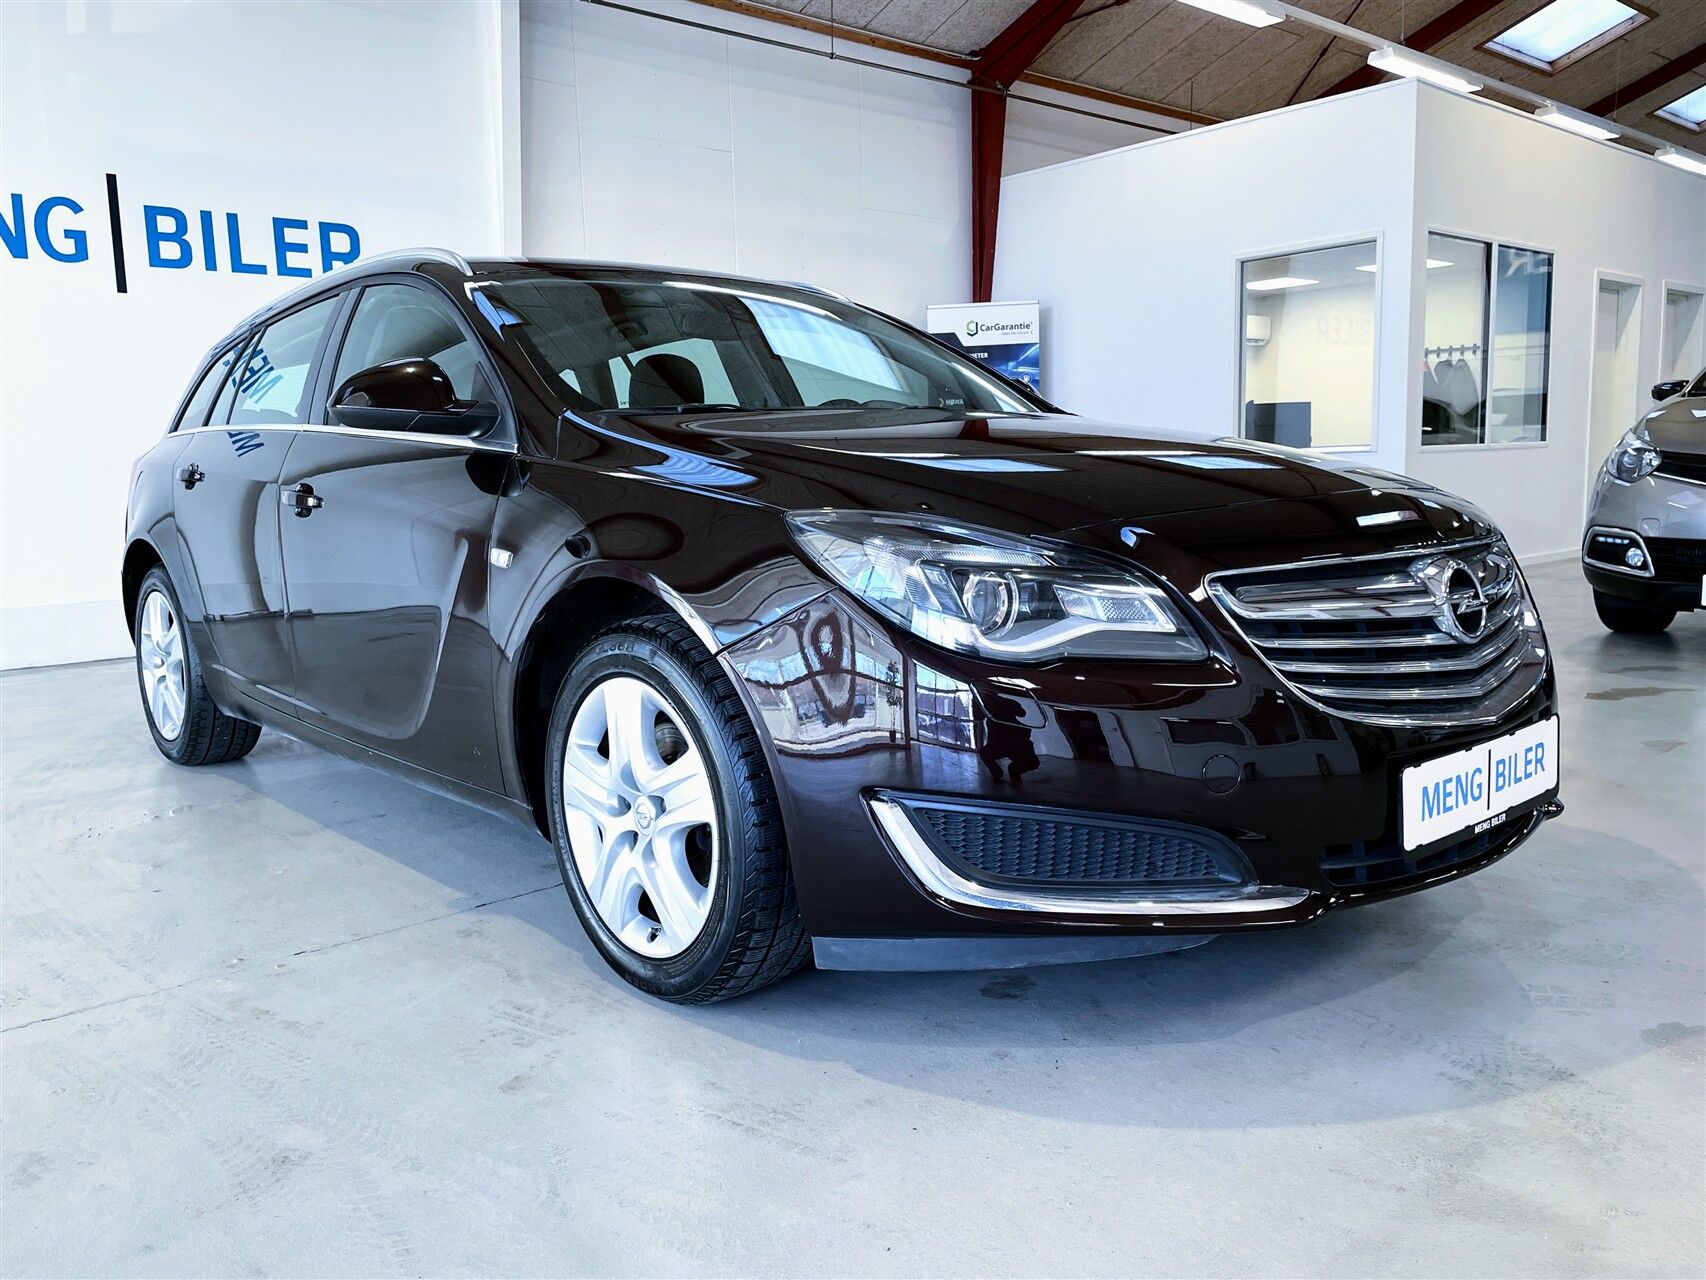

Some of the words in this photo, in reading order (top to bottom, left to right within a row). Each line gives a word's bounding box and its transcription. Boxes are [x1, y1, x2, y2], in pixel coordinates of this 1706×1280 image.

[143, 204, 361, 278] BILER
[1421, 767, 1483, 822] MENG
[1495, 742, 1546, 793] BILER
[1474, 819, 1491, 834] MENG
[1491, 812, 1506, 827] BILER
